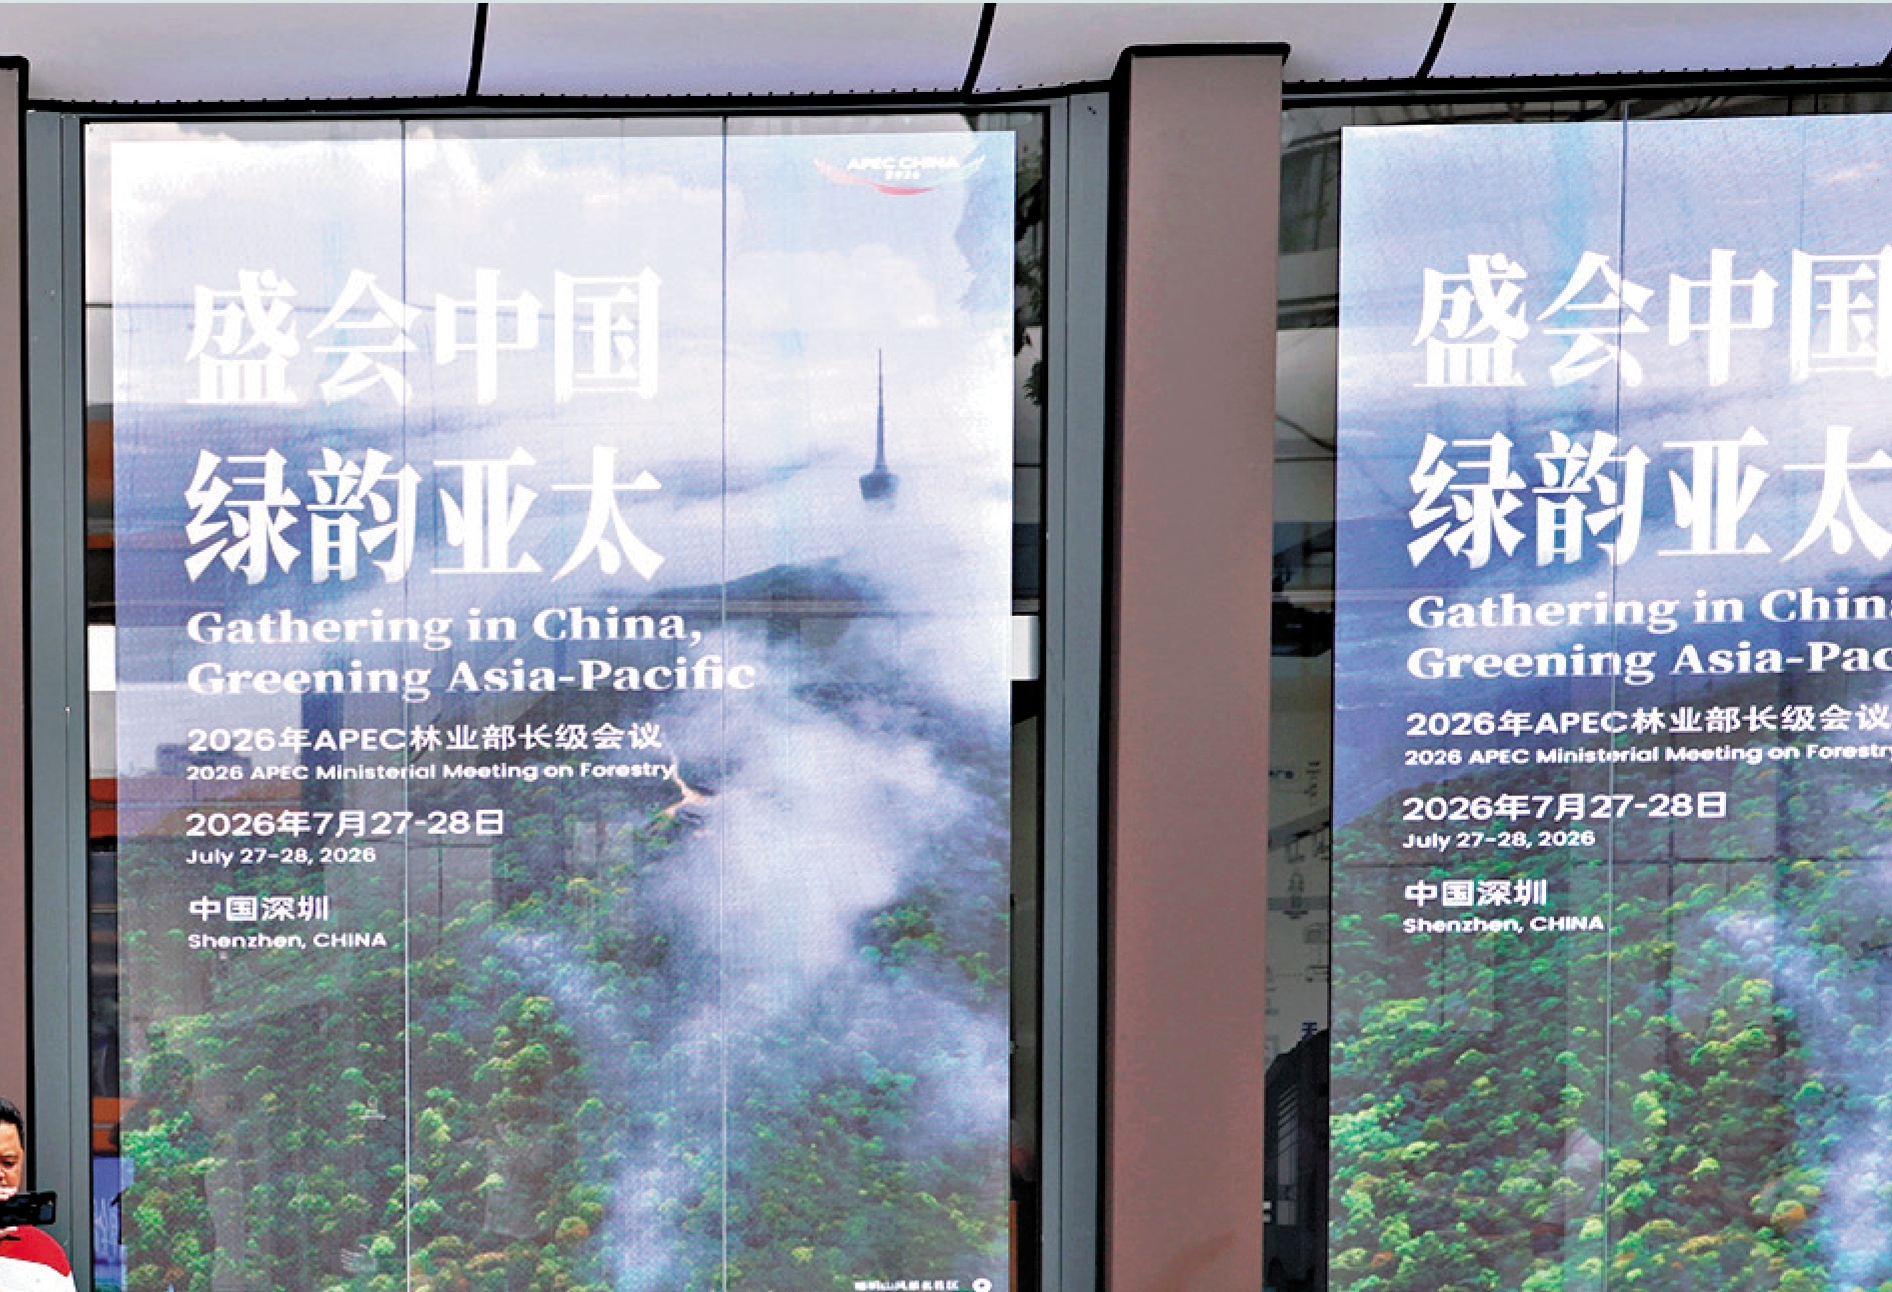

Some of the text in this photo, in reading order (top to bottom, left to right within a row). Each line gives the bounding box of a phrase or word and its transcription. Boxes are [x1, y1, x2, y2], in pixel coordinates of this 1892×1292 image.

[1412, 243, 1892, 390] 盛会中国
[184, 266, 664, 407] 盛会中国
[1407, 425, 1892, 568] 绿韵亚太
[183, 446, 665, 584] 绿韵亚太
[1407, 586, 1892, 635] Gathering in Chin
[186, 606, 702, 651] Gathering in China,
[186, 655, 756, 703] Greening Asia-Pacific
[1407, 644, 1657, 686] Greening
[1406, 703, 1892, 738] 2026年APEC林业部长级会议
[186, 722, 663, 754] 2026年APEC林业部长级会议
[1404, 742, 1892, 766] 2026 APEC Ministerial Meeting on Forestr
[186, 762, 675, 782] 2026 APEC Ministerial Meeting on Forestry
[1402, 791, 1727, 821] 2026年7月27-28日
[185, 810, 504, 838] 2026年7月27-28日
[1402, 833, 1451, 851] July
[1538, 830, 1596, 847] 2026
[185, 848, 234, 868] July
[320, 847, 377, 863] 2026
[1405, 879, 1547, 907] 中国深圳
[189, 896, 329, 922] 中国深圳
[1402, 916, 1605, 934] Shenzhen, CHINA
[187, 932, 388, 950] Shenzhen, CHINA
